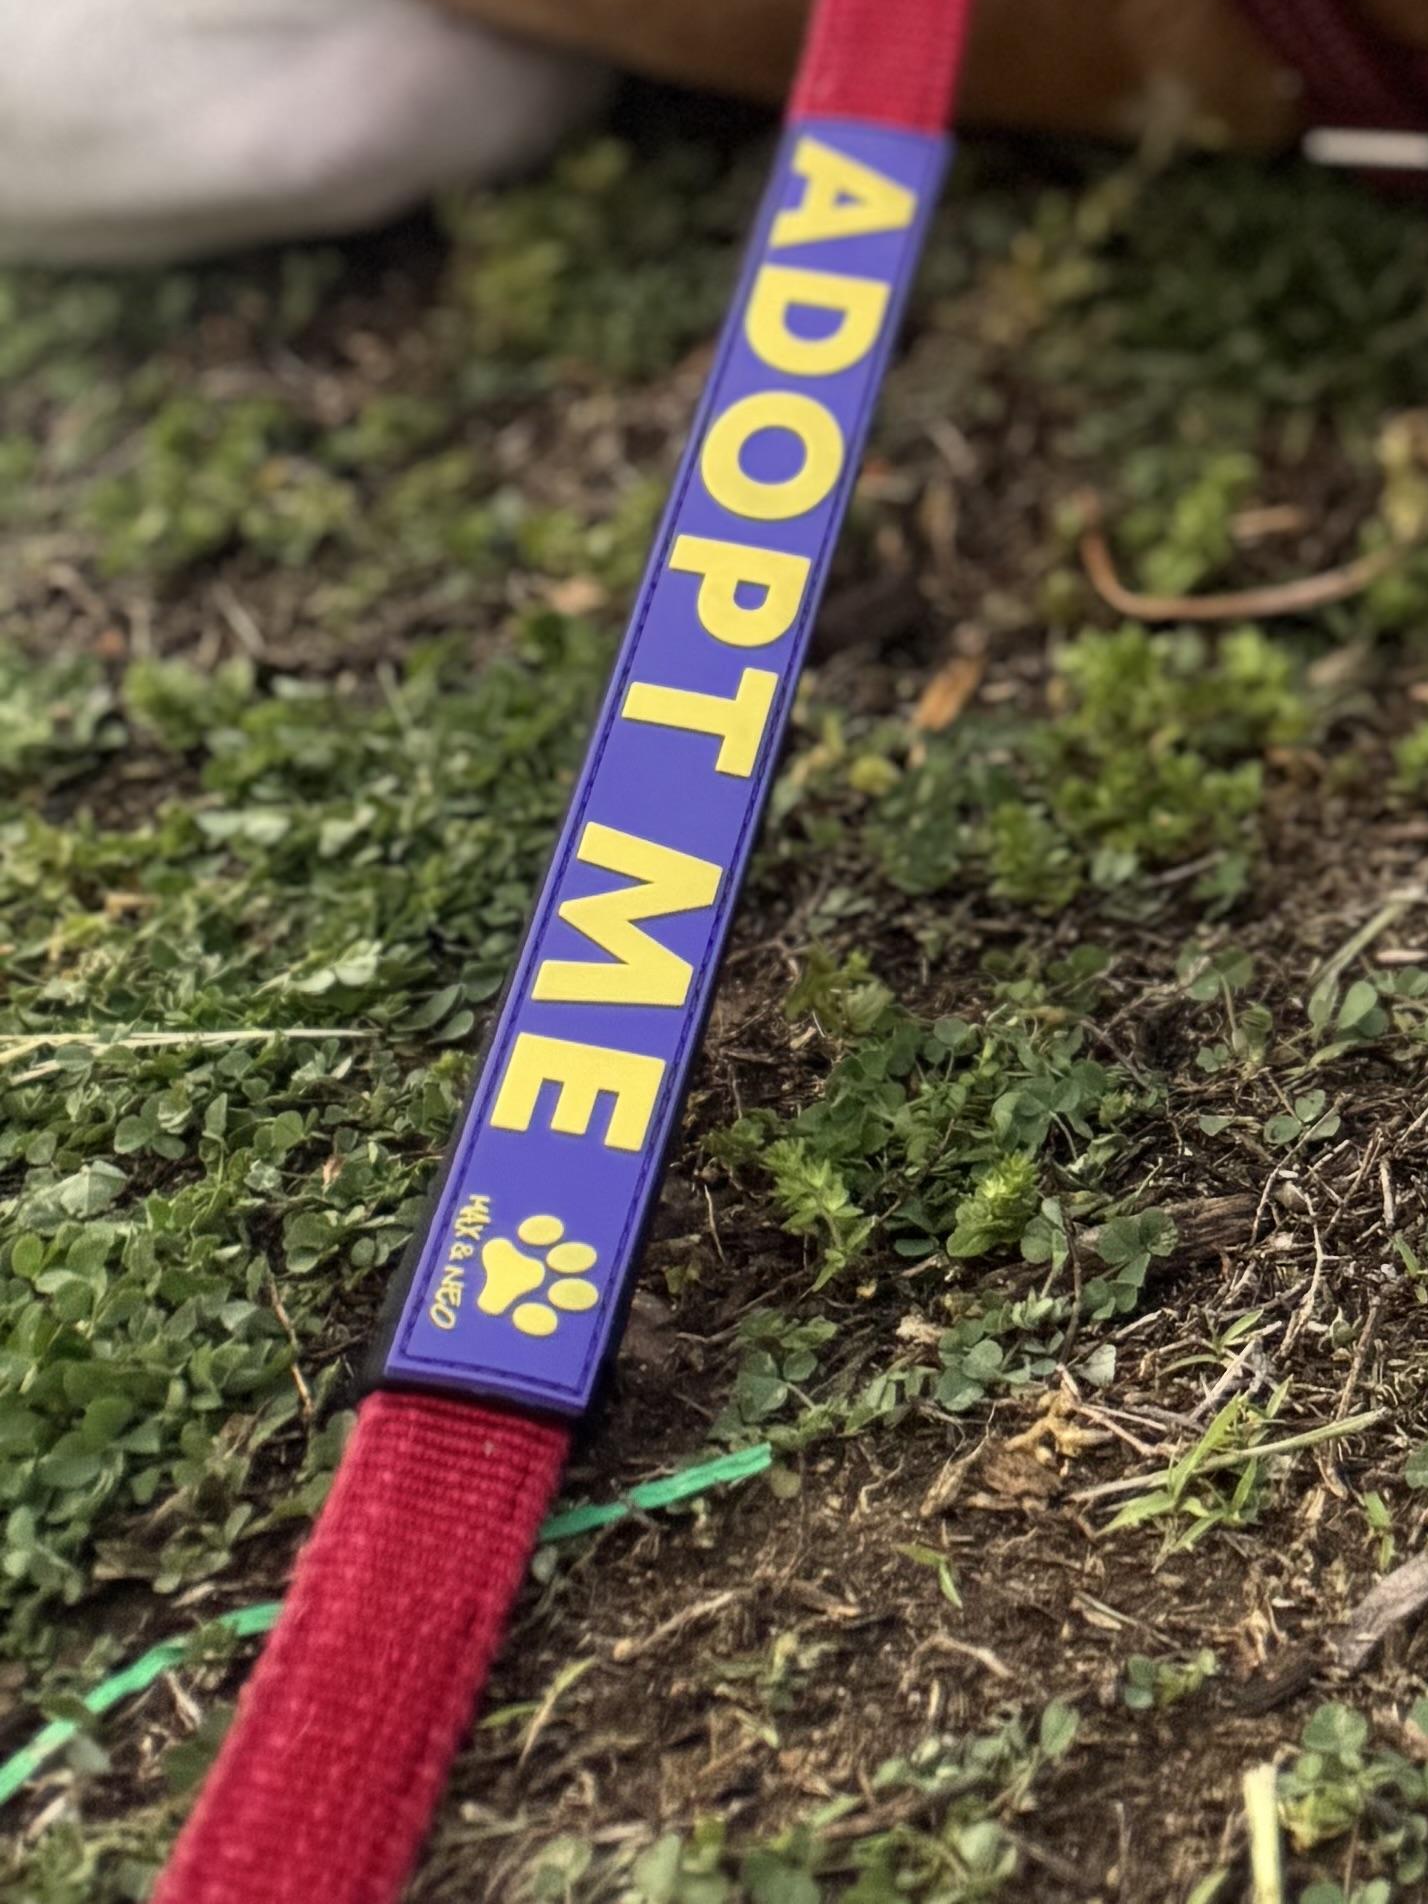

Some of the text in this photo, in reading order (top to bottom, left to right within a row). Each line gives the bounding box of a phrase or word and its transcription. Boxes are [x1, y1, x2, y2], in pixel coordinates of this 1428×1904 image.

[489, 138, 918, 1153] ADOPT ME
[430, 1194, 491, 1330] MAX & NEO
